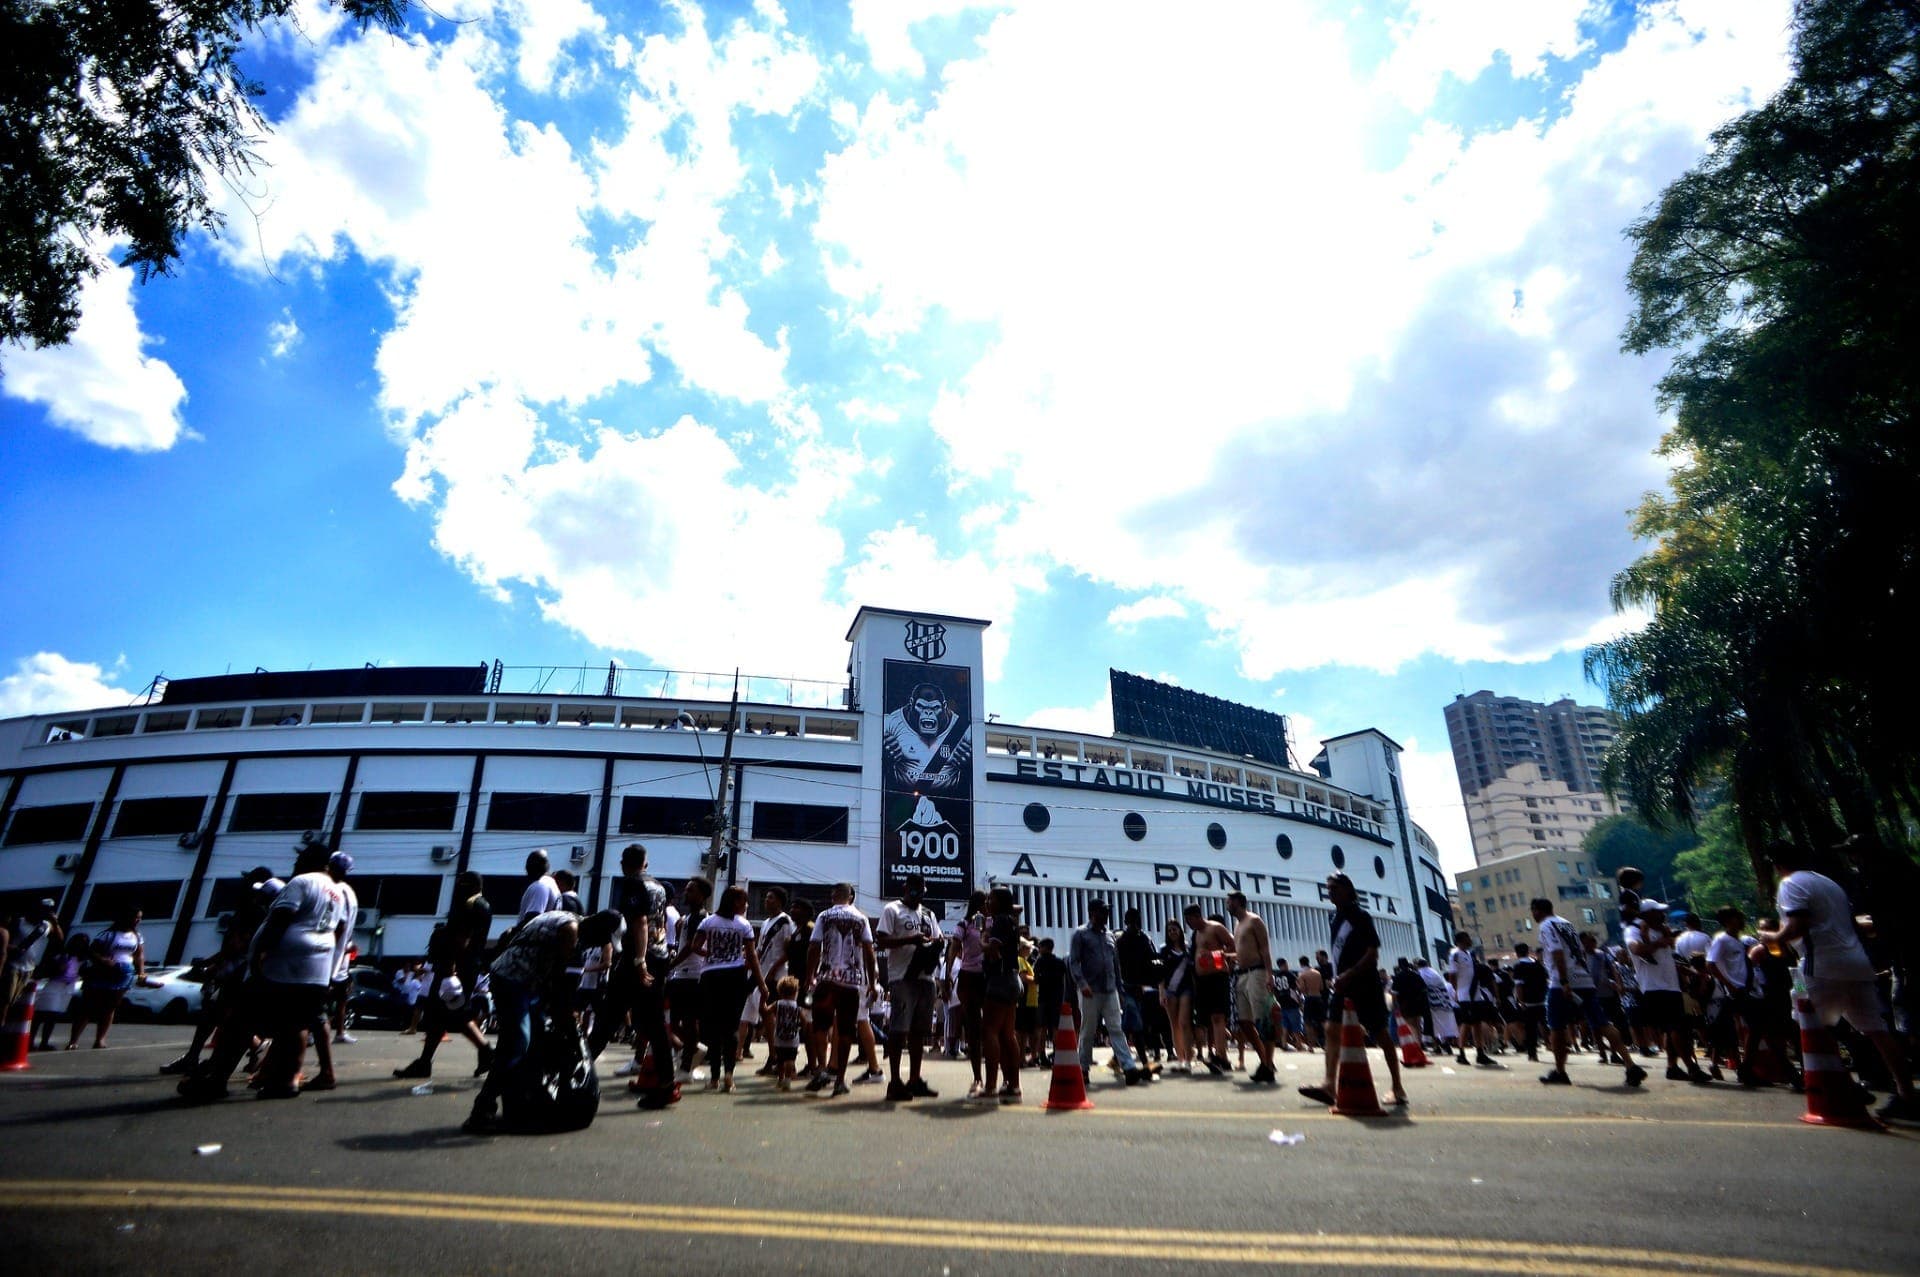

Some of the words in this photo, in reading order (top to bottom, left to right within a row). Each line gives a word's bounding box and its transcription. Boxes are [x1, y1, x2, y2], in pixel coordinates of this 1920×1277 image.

[1016, 759, 1165, 793] ESTADIO
[1187, 780, 1276, 811] MOISES
[1290, 799, 1383, 840] LUCARELLI
[900, 830, 959, 860] 1900
[1011, 853, 1048, 879] A.
[1084, 858, 1119, 883] A.
[1154, 863, 1292, 898] PONTE
[1317, 882, 1398, 916] PETA
